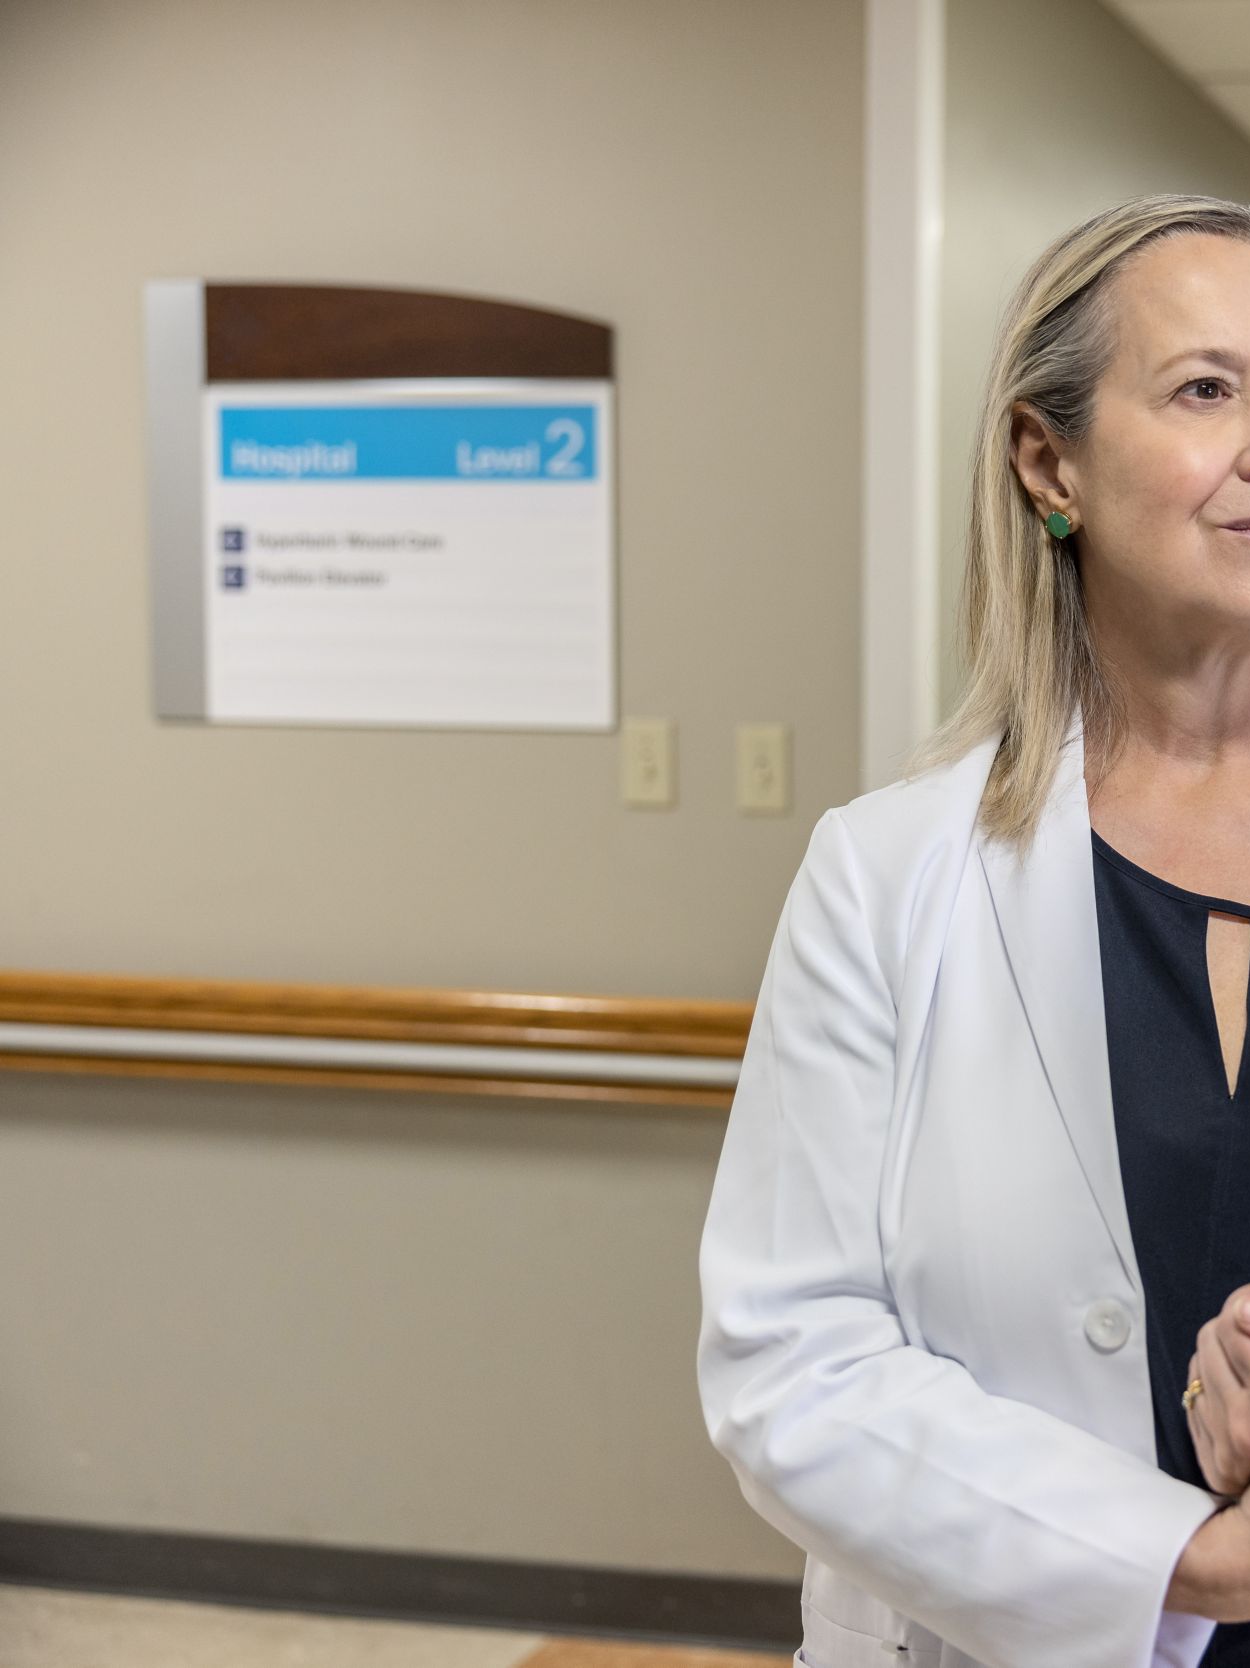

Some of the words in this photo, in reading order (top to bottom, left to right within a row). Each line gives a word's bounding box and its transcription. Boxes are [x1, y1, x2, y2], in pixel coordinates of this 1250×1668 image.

[231, 440, 356, 476] Hospital
[457, 440, 539, 474] Level
[547, 420, 585, 475] 2
